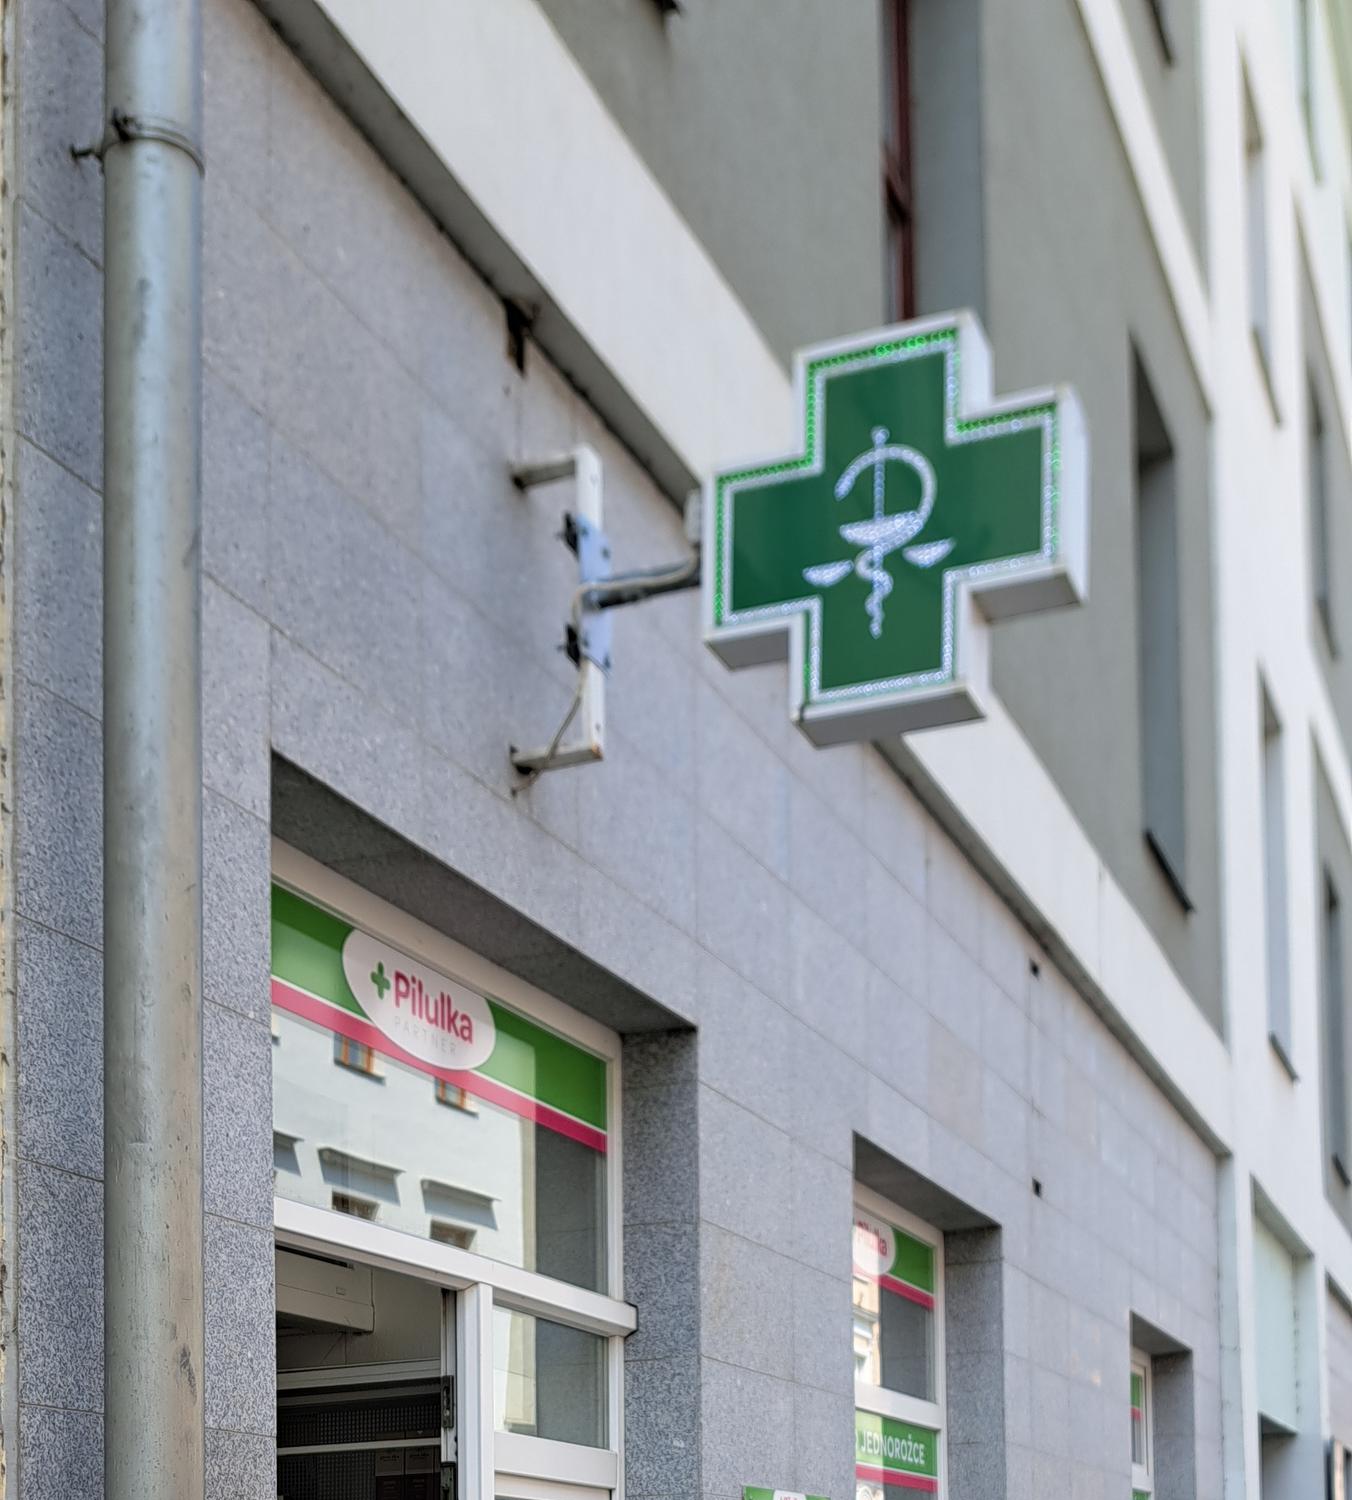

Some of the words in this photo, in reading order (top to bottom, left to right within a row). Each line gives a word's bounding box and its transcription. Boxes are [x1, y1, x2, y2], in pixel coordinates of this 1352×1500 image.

[394, 970, 473, 1044] Pilulka
[393, 1015, 457, 1056] PARTNER
[861, 1429, 925, 1465] JEDNOROŽCE
